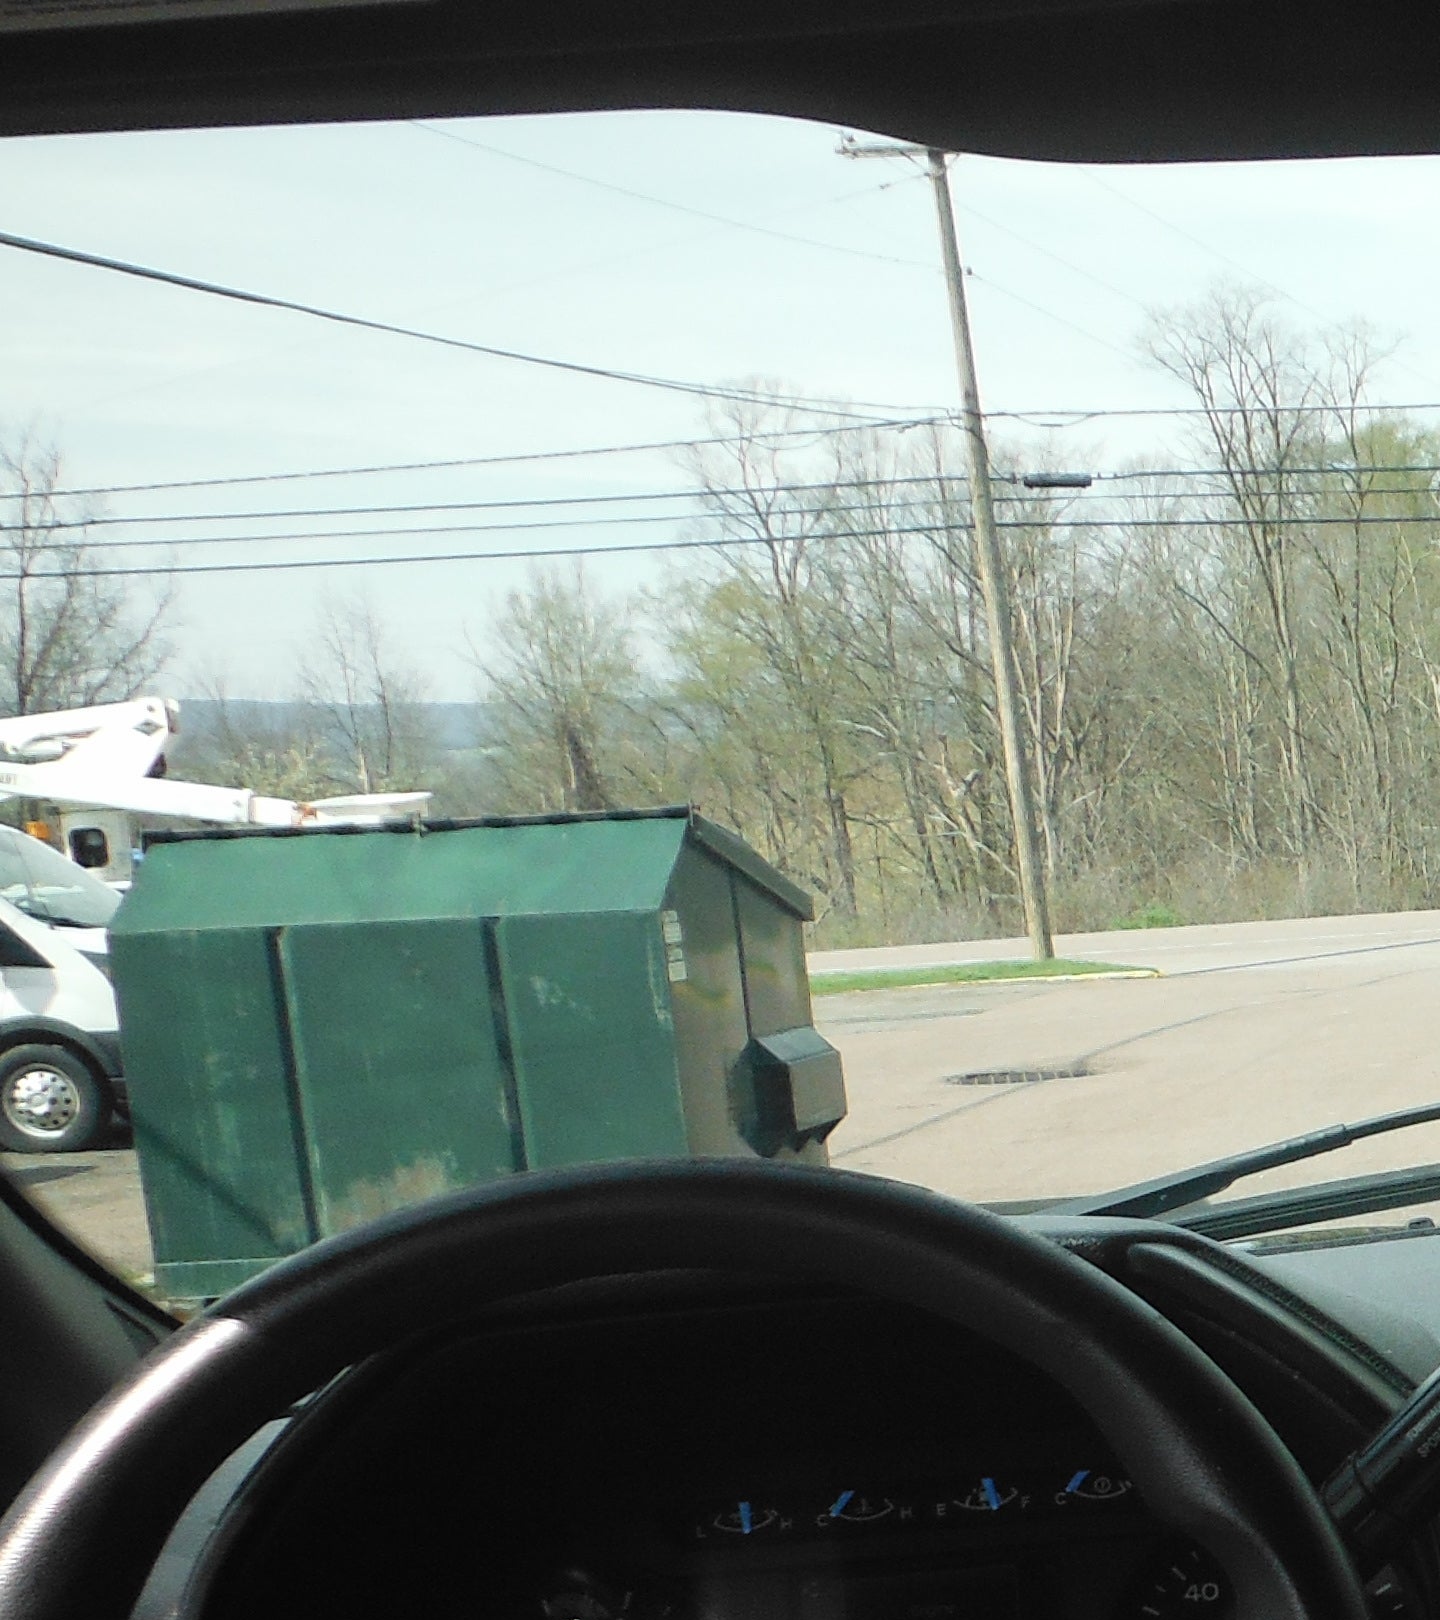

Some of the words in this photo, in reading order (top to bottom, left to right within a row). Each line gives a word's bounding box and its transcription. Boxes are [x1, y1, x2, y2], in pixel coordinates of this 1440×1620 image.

[900, 1505, 912, 1519] H
[936, 1503, 946, 1517] E
[1021, 1496, 1031, 1508] F
[1184, 1582, 1219, 1602] 40
